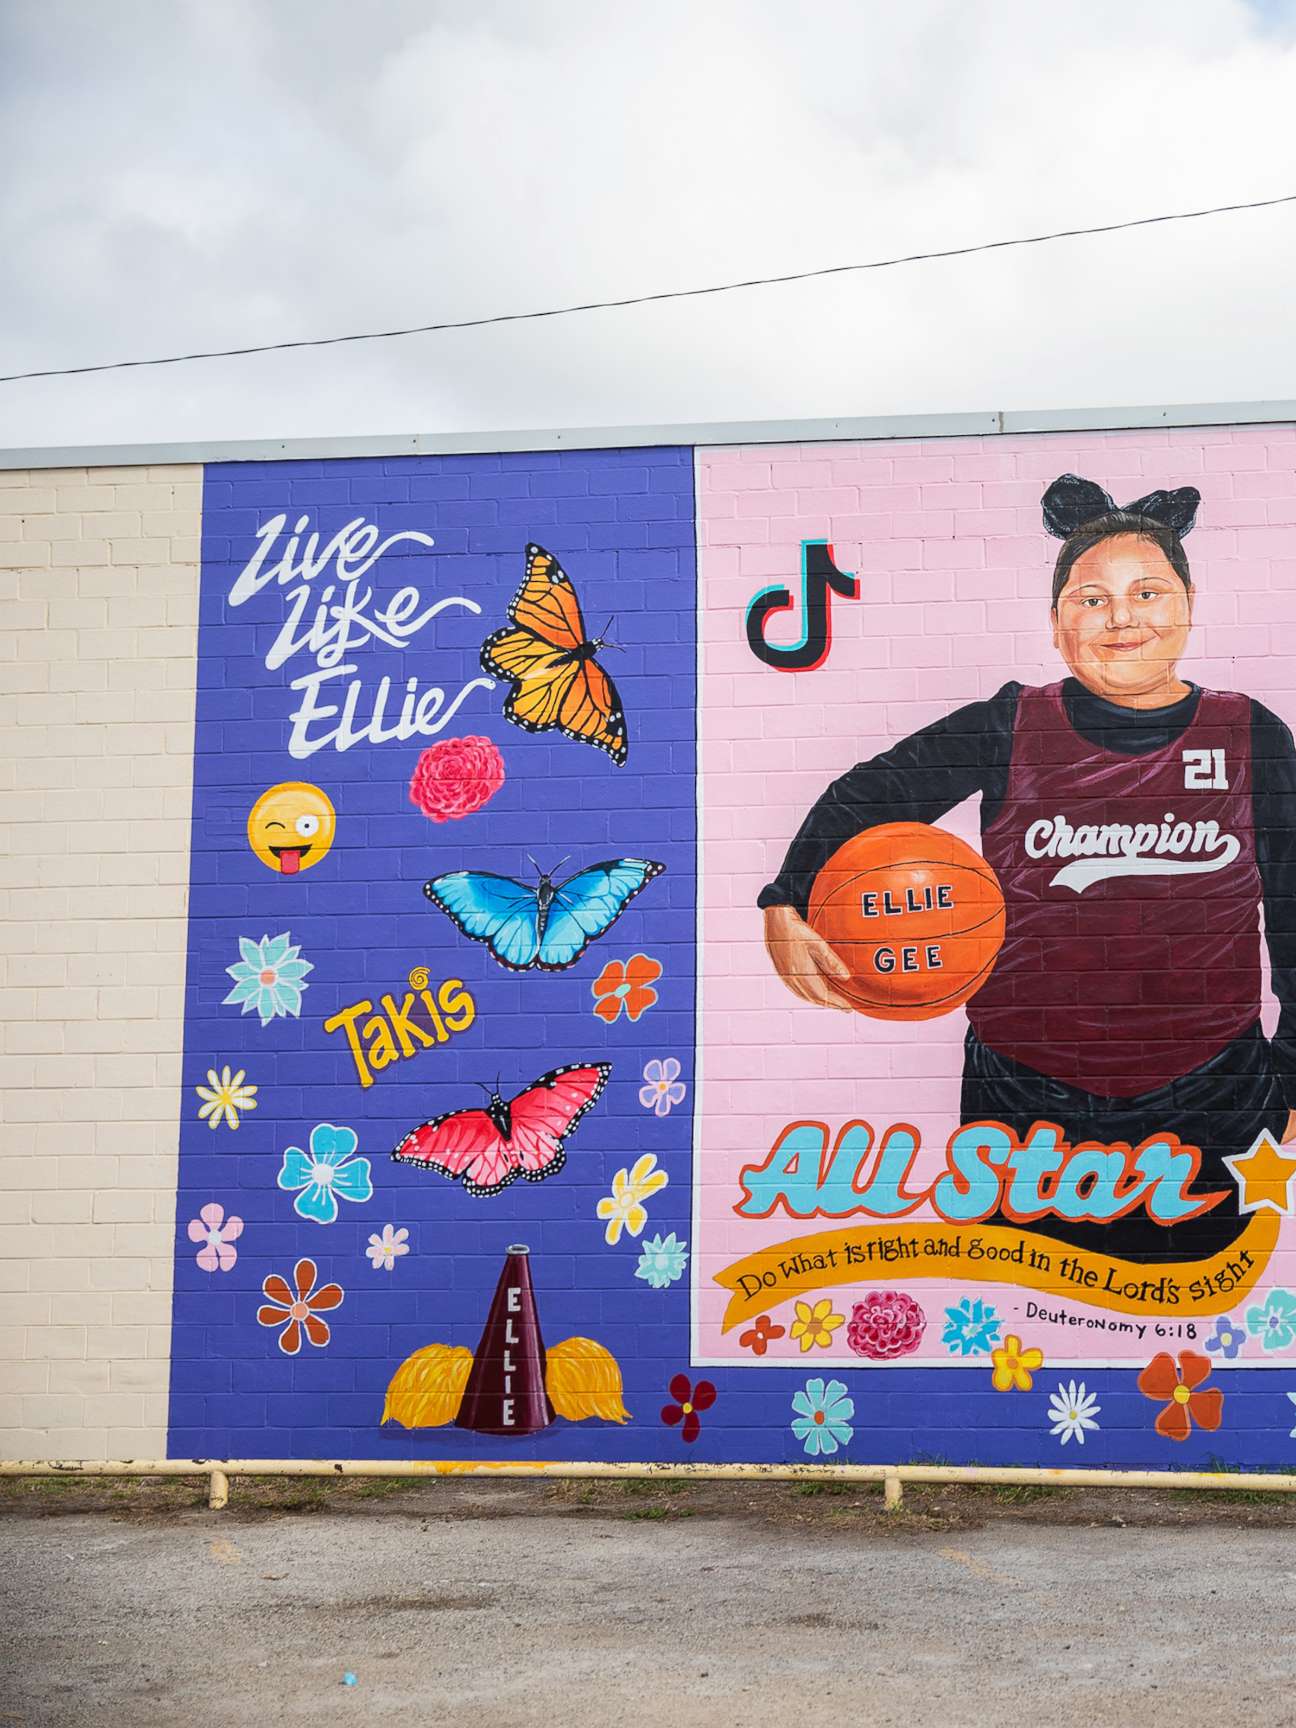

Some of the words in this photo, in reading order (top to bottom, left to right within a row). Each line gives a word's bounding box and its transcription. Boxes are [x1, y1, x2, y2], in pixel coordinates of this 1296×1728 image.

[229, 513, 434, 607] Live
[265, 579, 481, 671] Like
[289, 664, 497, 760] Ellie
[1182, 748, 1229, 790] 21
[1024, 812, 1241, 880] Champion
[862, 885, 954, 918] ELLIE
[873, 945, 943, 973] GEE
[732, 1119, 938, 1219] All
[927, 1119, 1231, 1226] Star
[737, 1270, 777, 1301] Do
[778, 1249, 838, 1280] What
[844, 1242, 866, 1265] is
[866, 1236, 919, 1262] right
[924, 1235, 962, 1258] and
[967, 1238, 1024, 1264] good
[1029, 1248, 1051, 1273] in
[1059, 1258, 1098, 1288] the
[1103, 1267, 1180, 1305] Lord's
[1189, 1250, 1255, 1302] sight
[503, 1287, 522, 1426] ELLIE
[1155, 1322, 1198, 1340] 6:18
